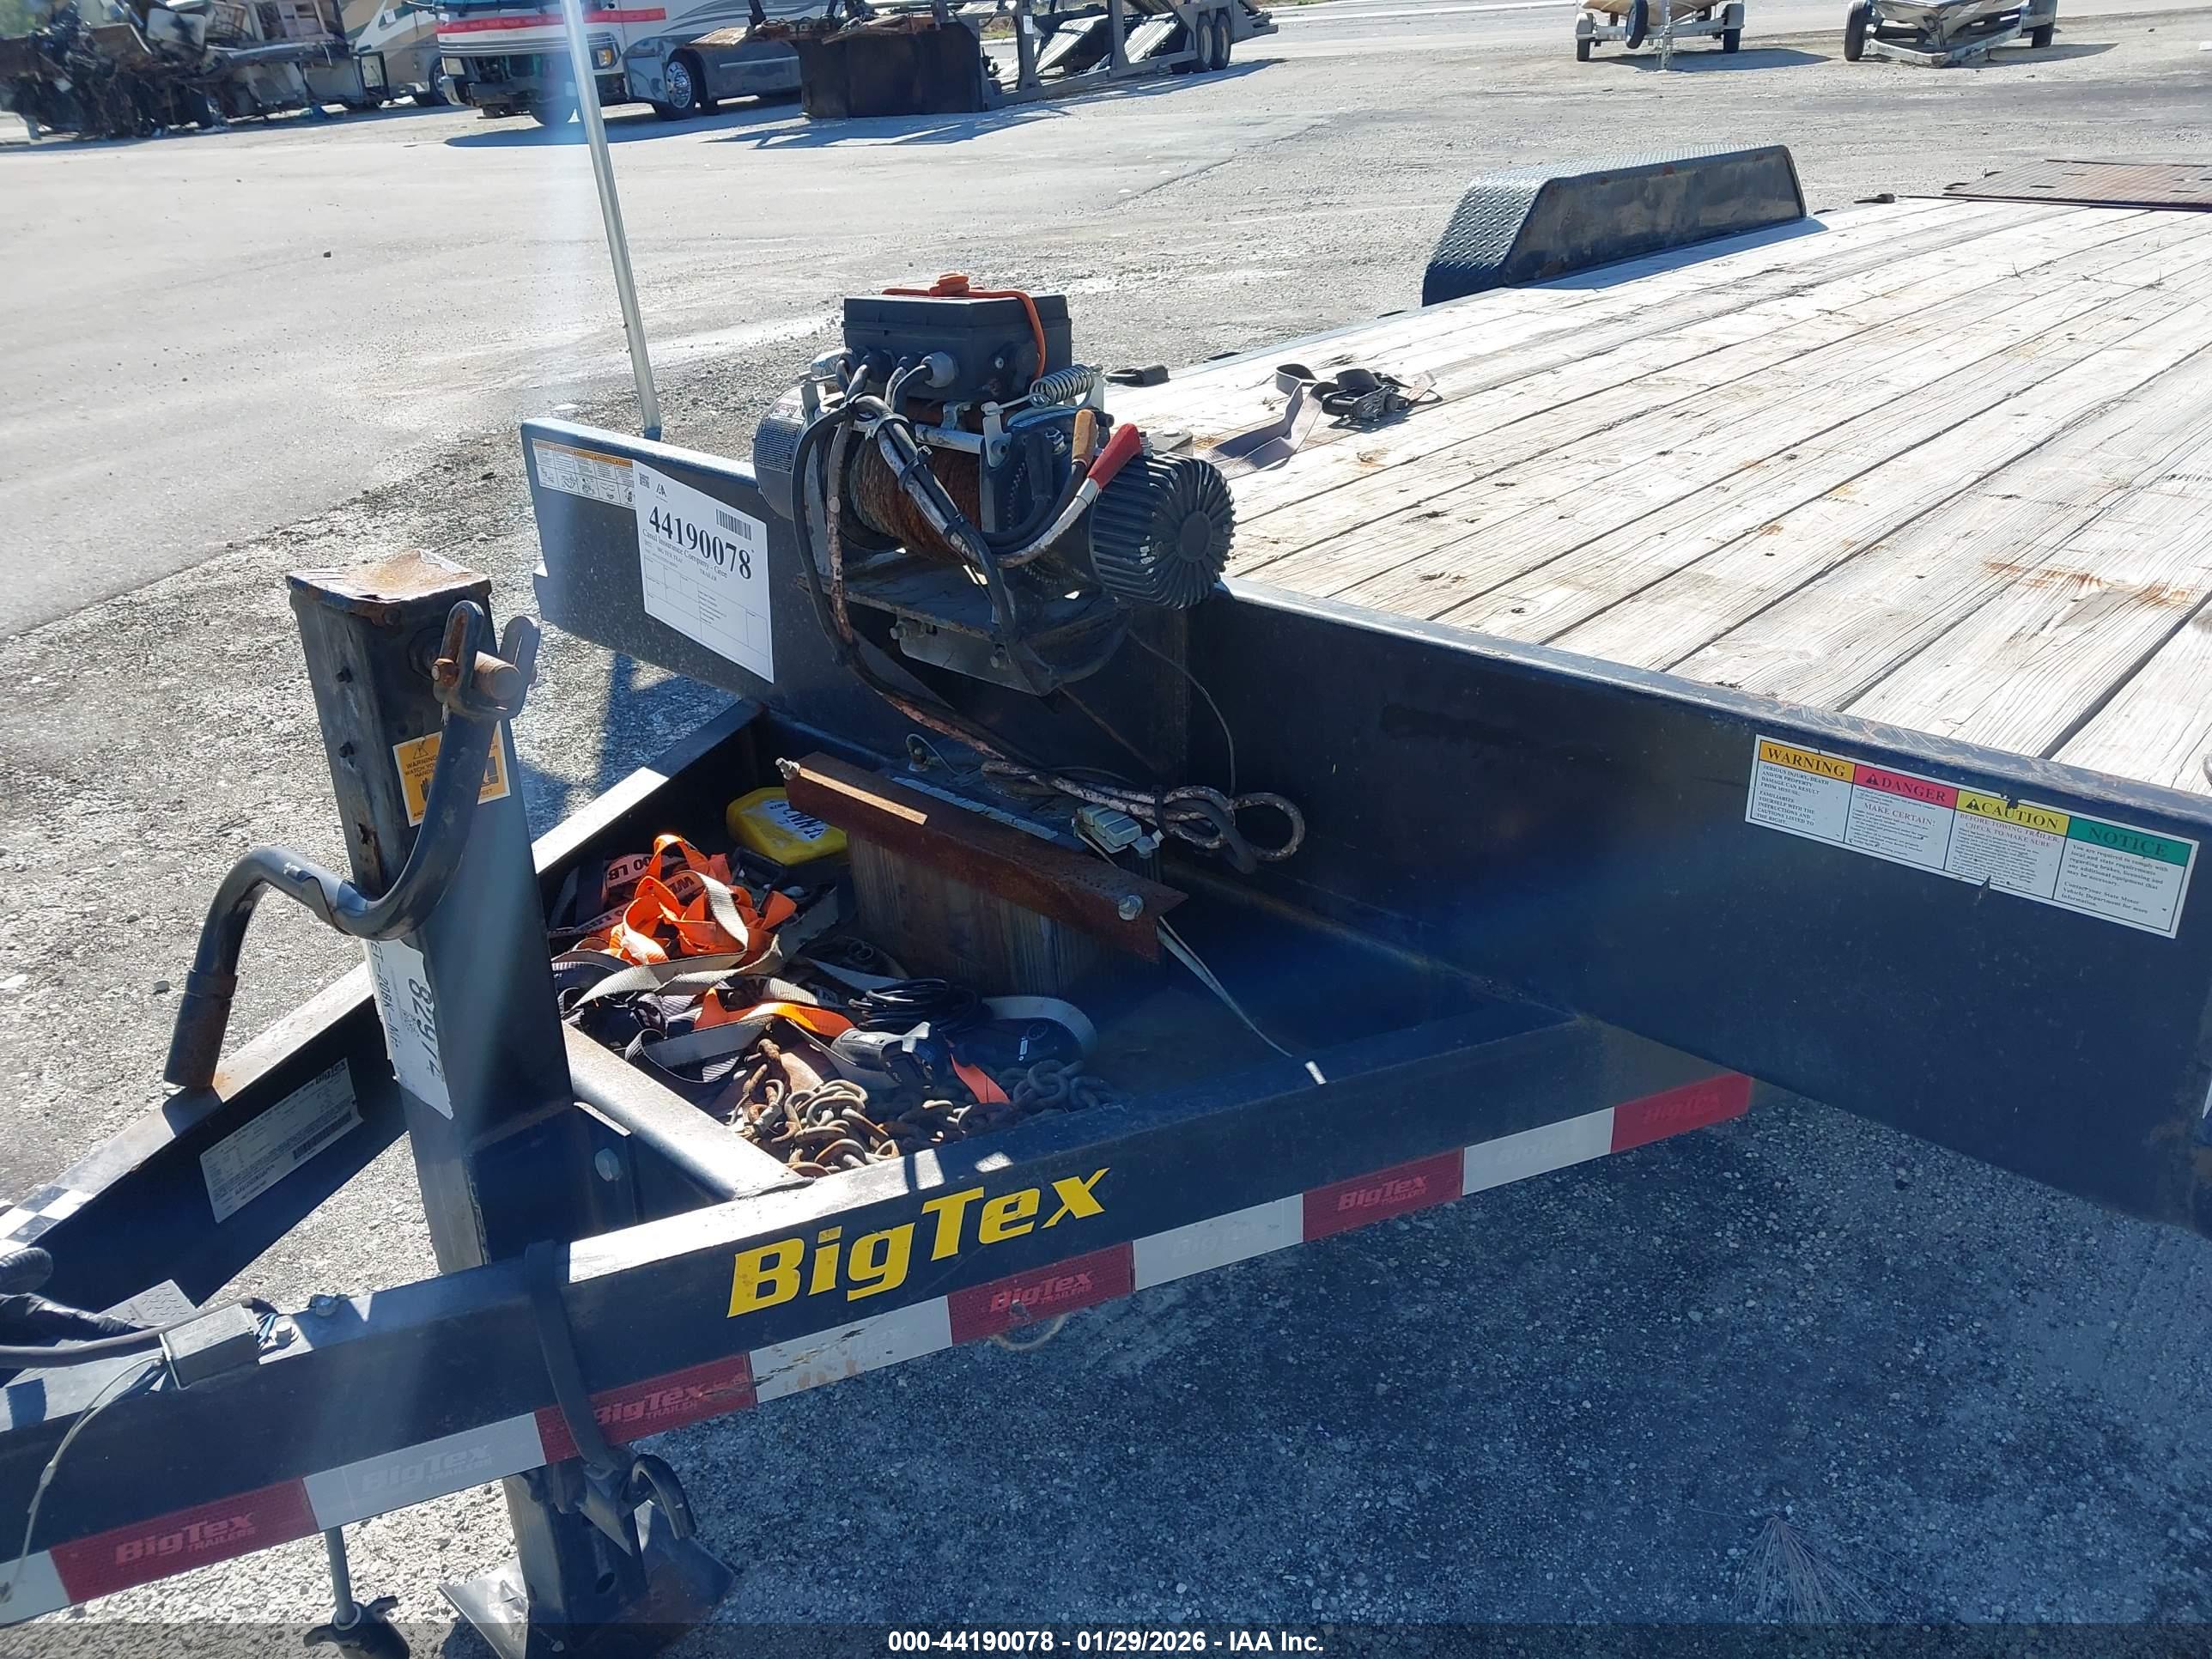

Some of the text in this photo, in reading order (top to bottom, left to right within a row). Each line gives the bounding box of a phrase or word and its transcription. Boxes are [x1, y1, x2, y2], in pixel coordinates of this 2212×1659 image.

[648, 505, 752, 580] 44190078
[684, 549, 708, 571] Company
[1766, 747, 1845, 777] WARNING
[1881, 777, 1946, 802] DANGER
[1863, 802, 1890, 815] MAKE
[1892, 809, 1936, 827] CERTAIN!
[1960, 812, 1987, 824] BEFORE
[1991, 821, 2022, 833] TOWING
[1980, 801, 2058, 830] CAUTION
[1965, 822, 1991, 833] CHECK
[2006, 832, 2028, 842] MAKE
[2087, 826, 2169, 858] NOTICE
[2069, 856, 2099, 868] regarding
[2096, 850, 2123, 861] required
[2131, 859, 2153, 869] comply
[2154, 865, 2168, 873] with
[2115, 861, 2156, 877] requirements
[2080, 866, 2111, 878] additional
[2112, 874, 2143, 886] equipment
[2086, 893, 2120, 907] Department
[1337, 1174, 1429, 1212] BigTex
[726, 1166, 1111, 1319] BigTex
[989, 1270, 1094, 1313] BigTex
[362, 1443, 491, 1492] BigTex
[115, 1511, 257, 1567] BigTex
[187, 1525, 256, 1553] TRAILERS
